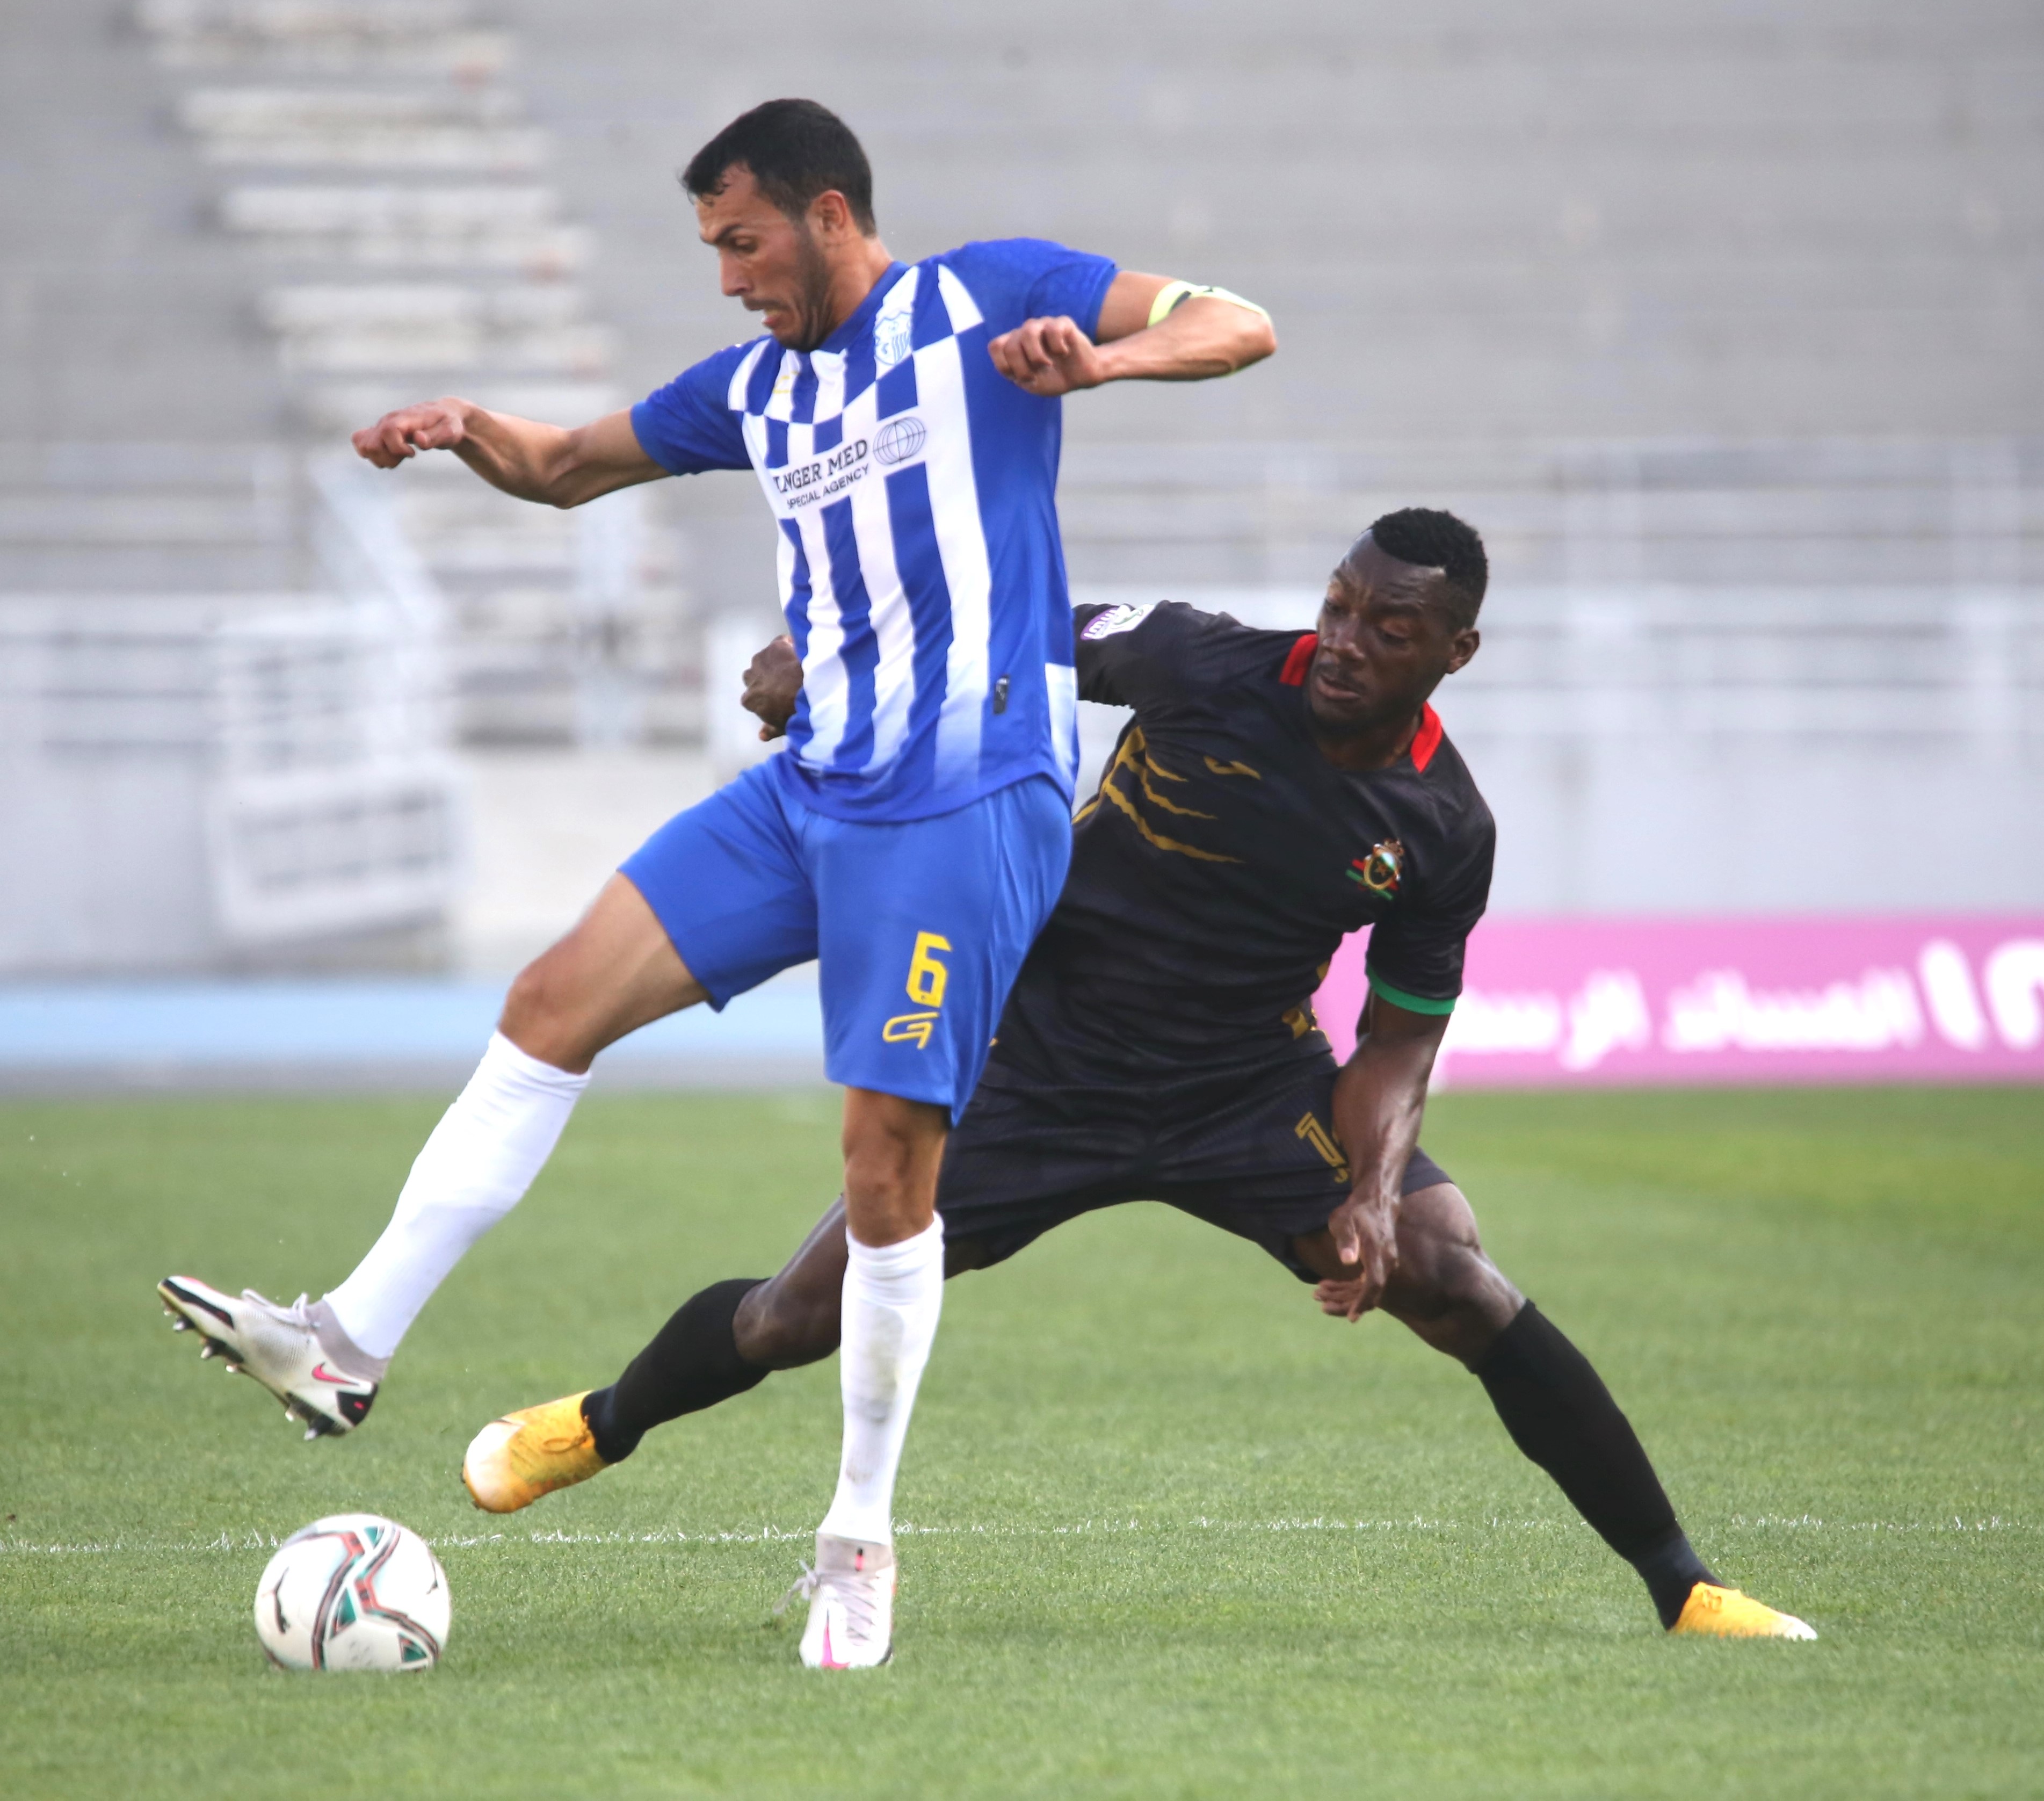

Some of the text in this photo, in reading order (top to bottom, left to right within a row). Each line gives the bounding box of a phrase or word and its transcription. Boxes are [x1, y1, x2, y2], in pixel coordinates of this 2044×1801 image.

[823, 463, 869, 497] AGENCY
[827, 439, 867, 476] MED
[905, 931, 953, 1008] 6
[1294, 1111, 1348, 1168] 1
